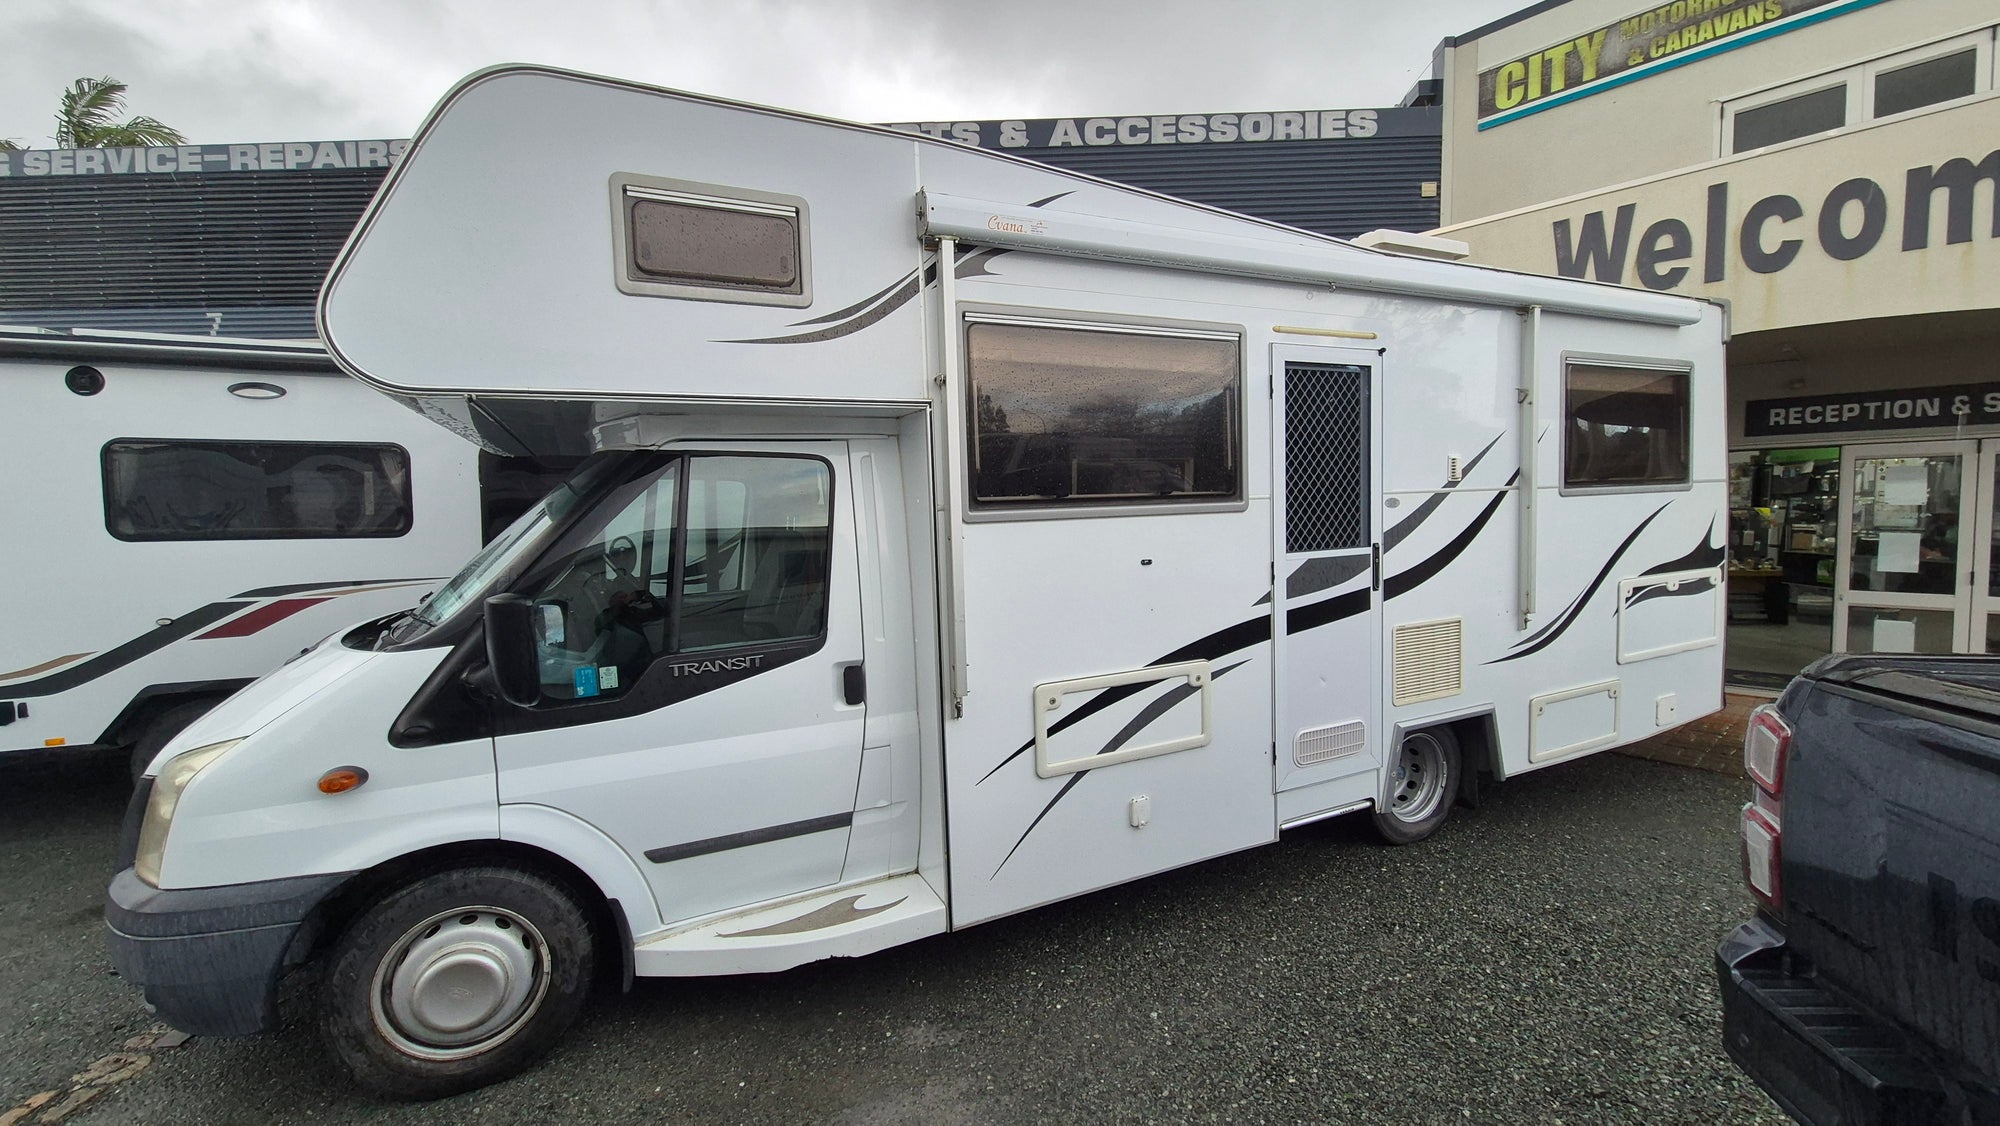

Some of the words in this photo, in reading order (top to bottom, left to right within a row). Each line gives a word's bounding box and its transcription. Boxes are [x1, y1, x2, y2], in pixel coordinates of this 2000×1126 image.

[1628, 49, 1645, 66] &
[1650, 0, 1783, 58] CARAVANS
[1495, 29, 1608, 110] CITY
[999, 120, 1029, 148] &
[1048, 110, 1378, 147] ACCESSORIES
[1768, 397, 1941, 426] RECEPTION
[1950, 395, 1972, 415] &
[668, 654, 764, 677] TRANSIT
